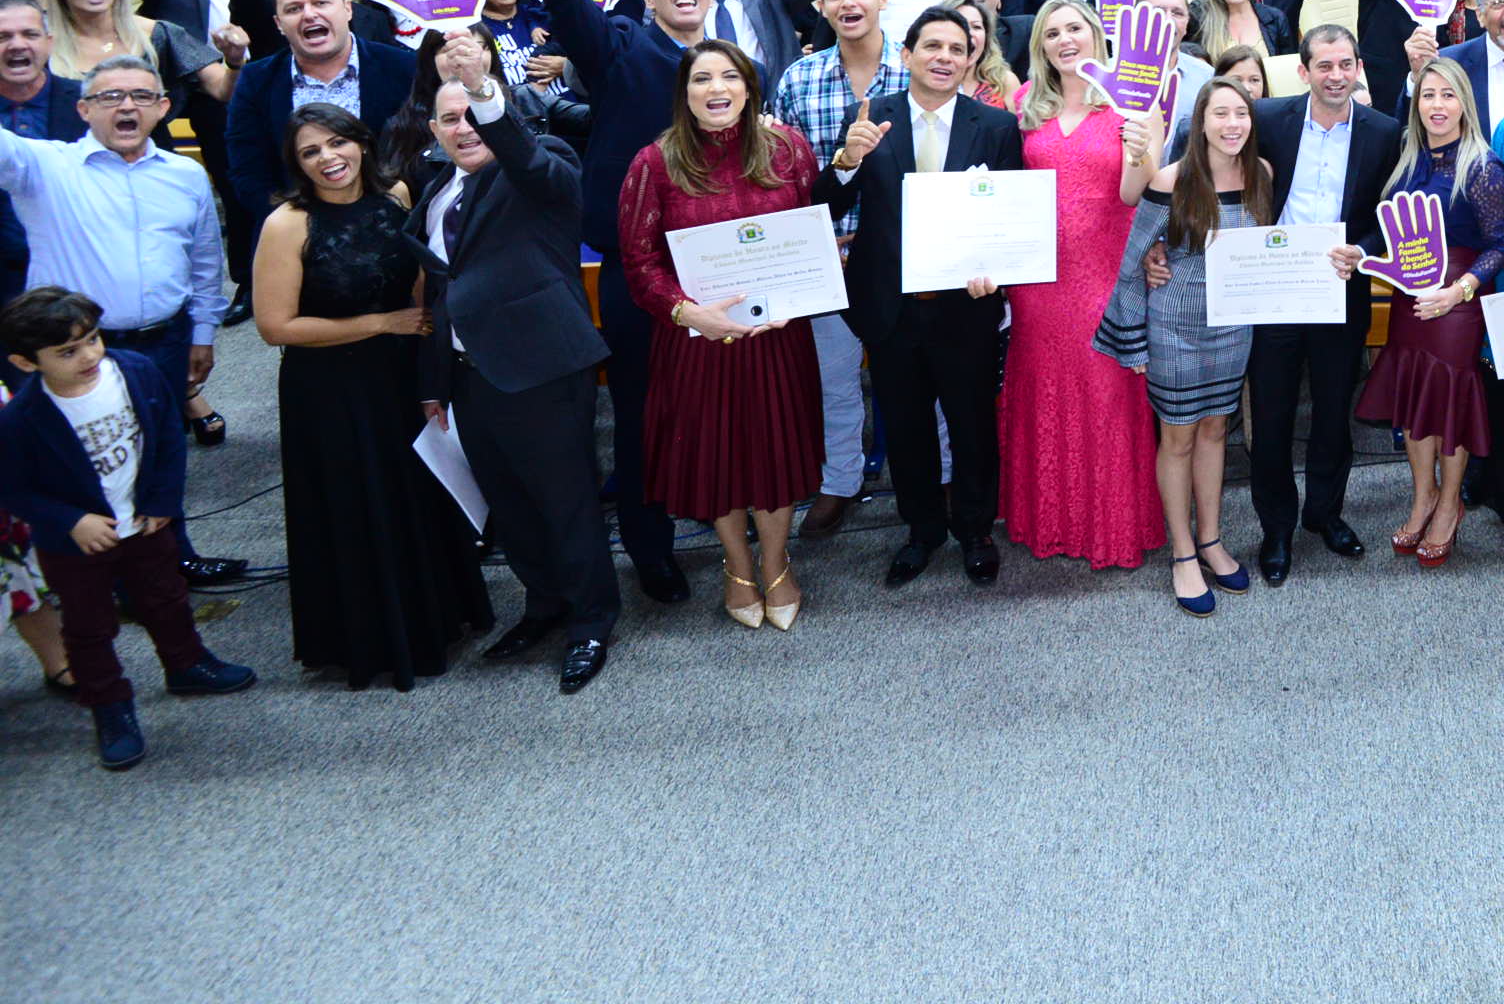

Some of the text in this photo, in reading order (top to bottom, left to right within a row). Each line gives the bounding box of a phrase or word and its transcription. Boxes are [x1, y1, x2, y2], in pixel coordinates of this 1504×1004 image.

[1405, 237, 1429, 248] minha
[1399, 246, 1426, 256] Família
[1412, 258, 1438, 270] Senhor
